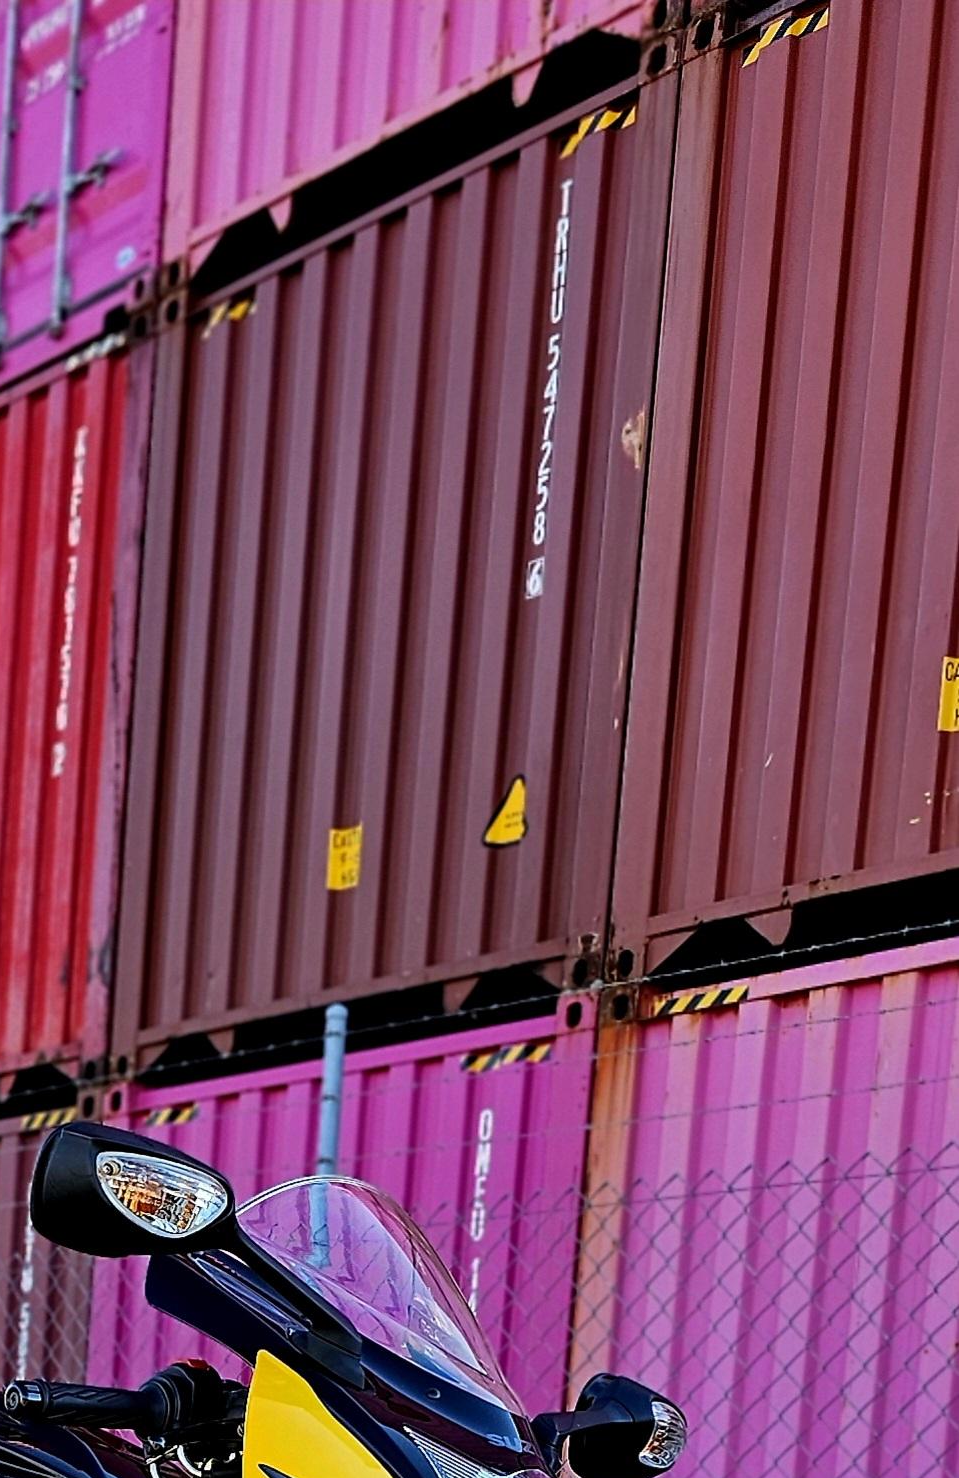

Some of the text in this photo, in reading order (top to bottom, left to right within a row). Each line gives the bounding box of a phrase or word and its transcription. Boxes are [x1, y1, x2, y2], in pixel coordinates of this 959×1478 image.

[551, 178, 573, 324] TRHU
[532, 334, 559, 545] 547258
[485, 1433, 536, 1456] SUZ
